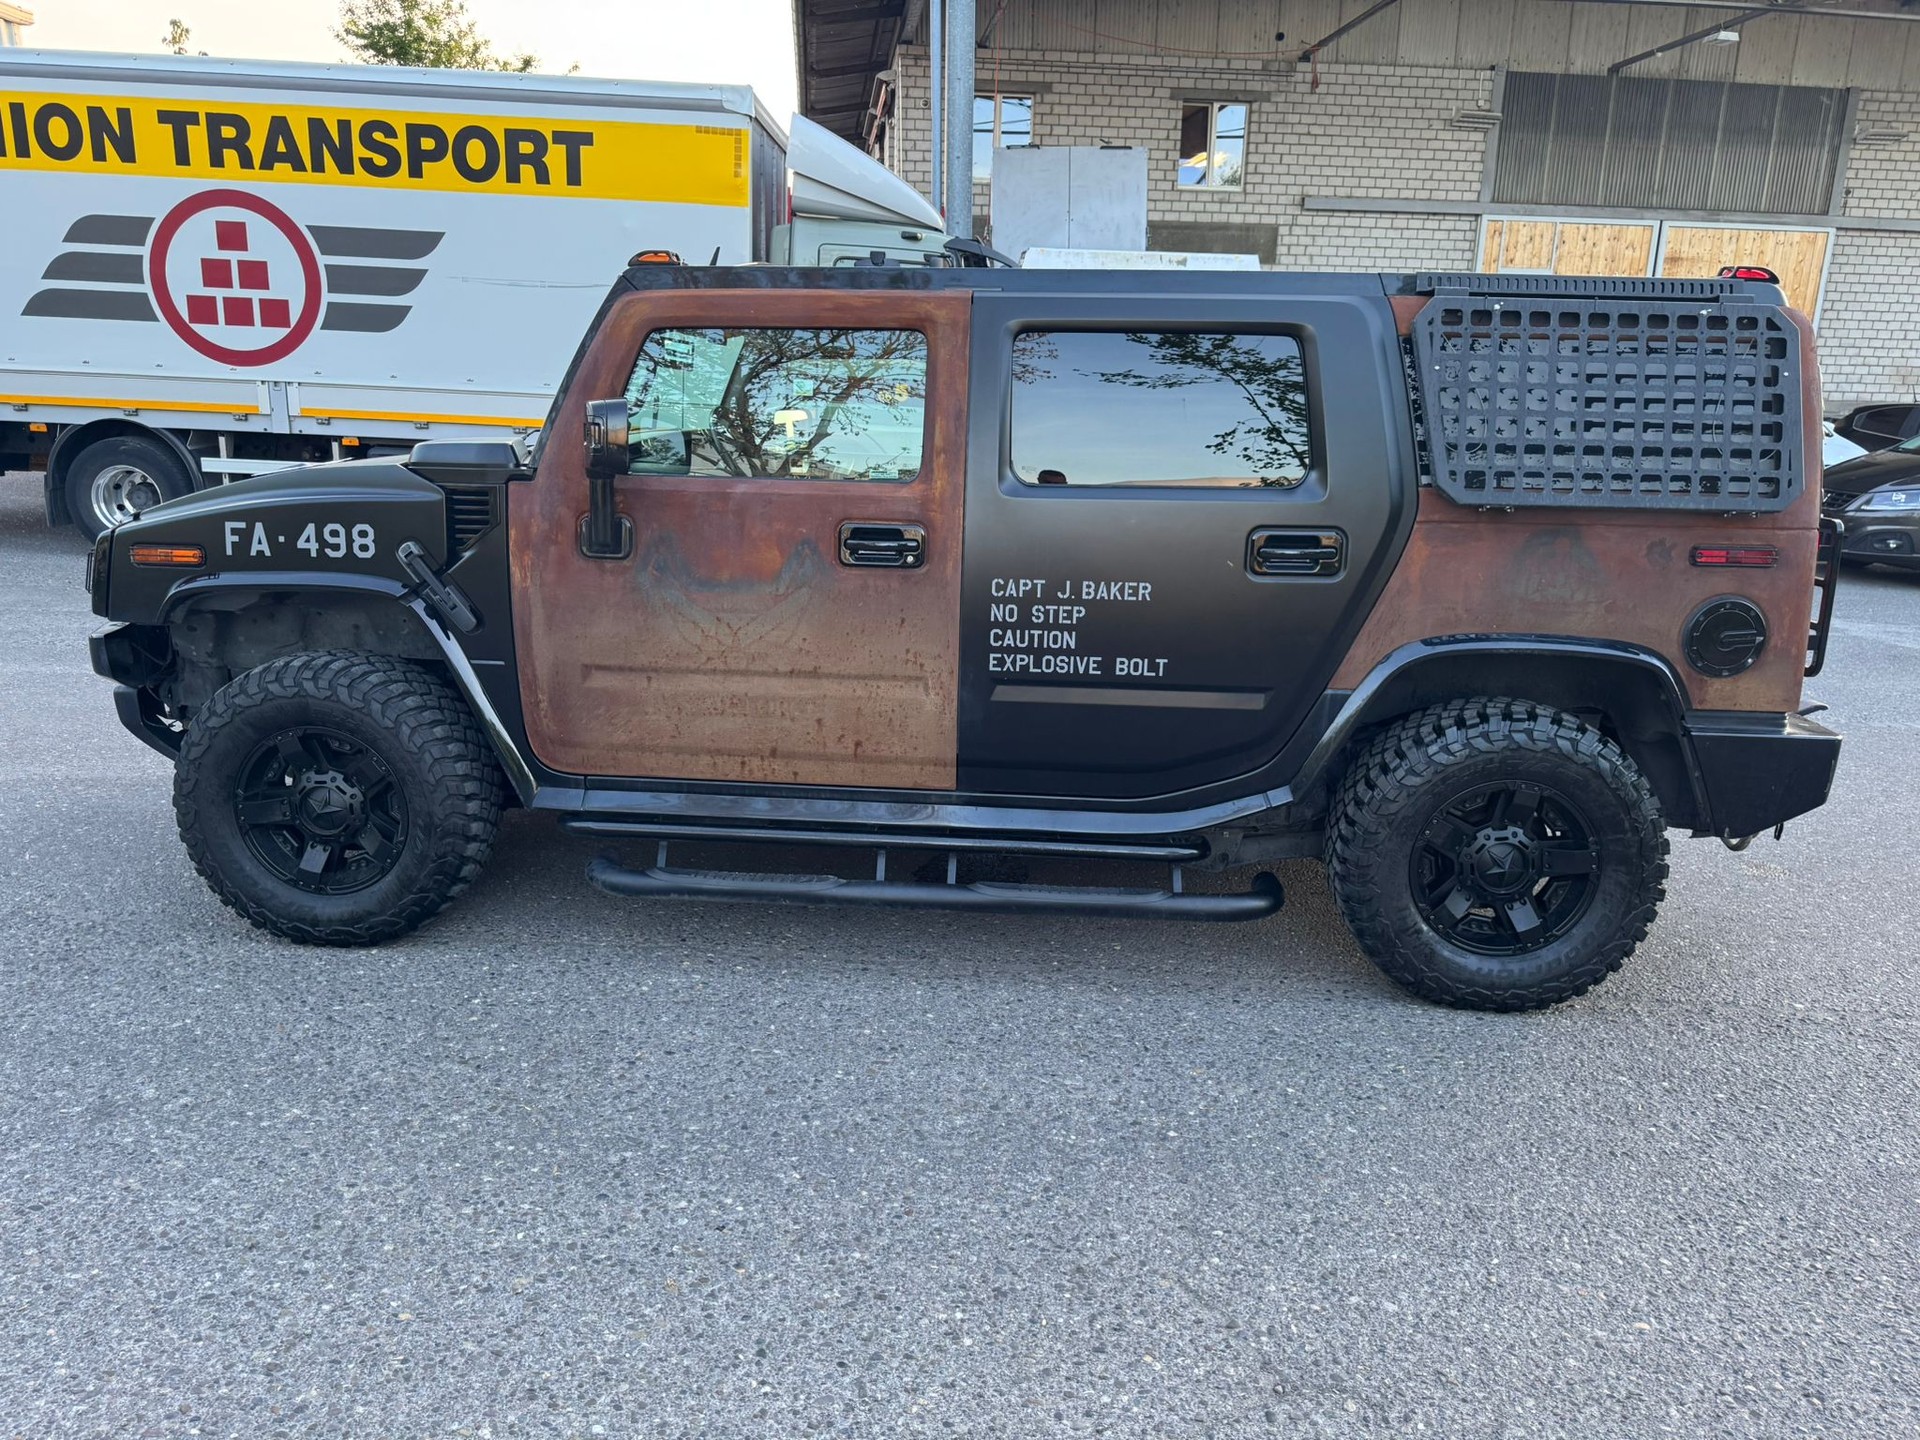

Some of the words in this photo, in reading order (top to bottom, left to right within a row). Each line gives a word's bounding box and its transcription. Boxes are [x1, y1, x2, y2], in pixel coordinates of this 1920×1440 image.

[0, 101, 137, 164] ION
[157, 109, 594, 187] TRANSPORT
[991, 578, 1046, 598] CAPT
[990, 603, 1018, 623] NO
[1031, 605, 1086, 624] STEP
[989, 628, 1076, 650] CAUTION
[988, 653, 1102, 675] EXPLOSIVE
[1115, 658, 1168, 677] BOLT
